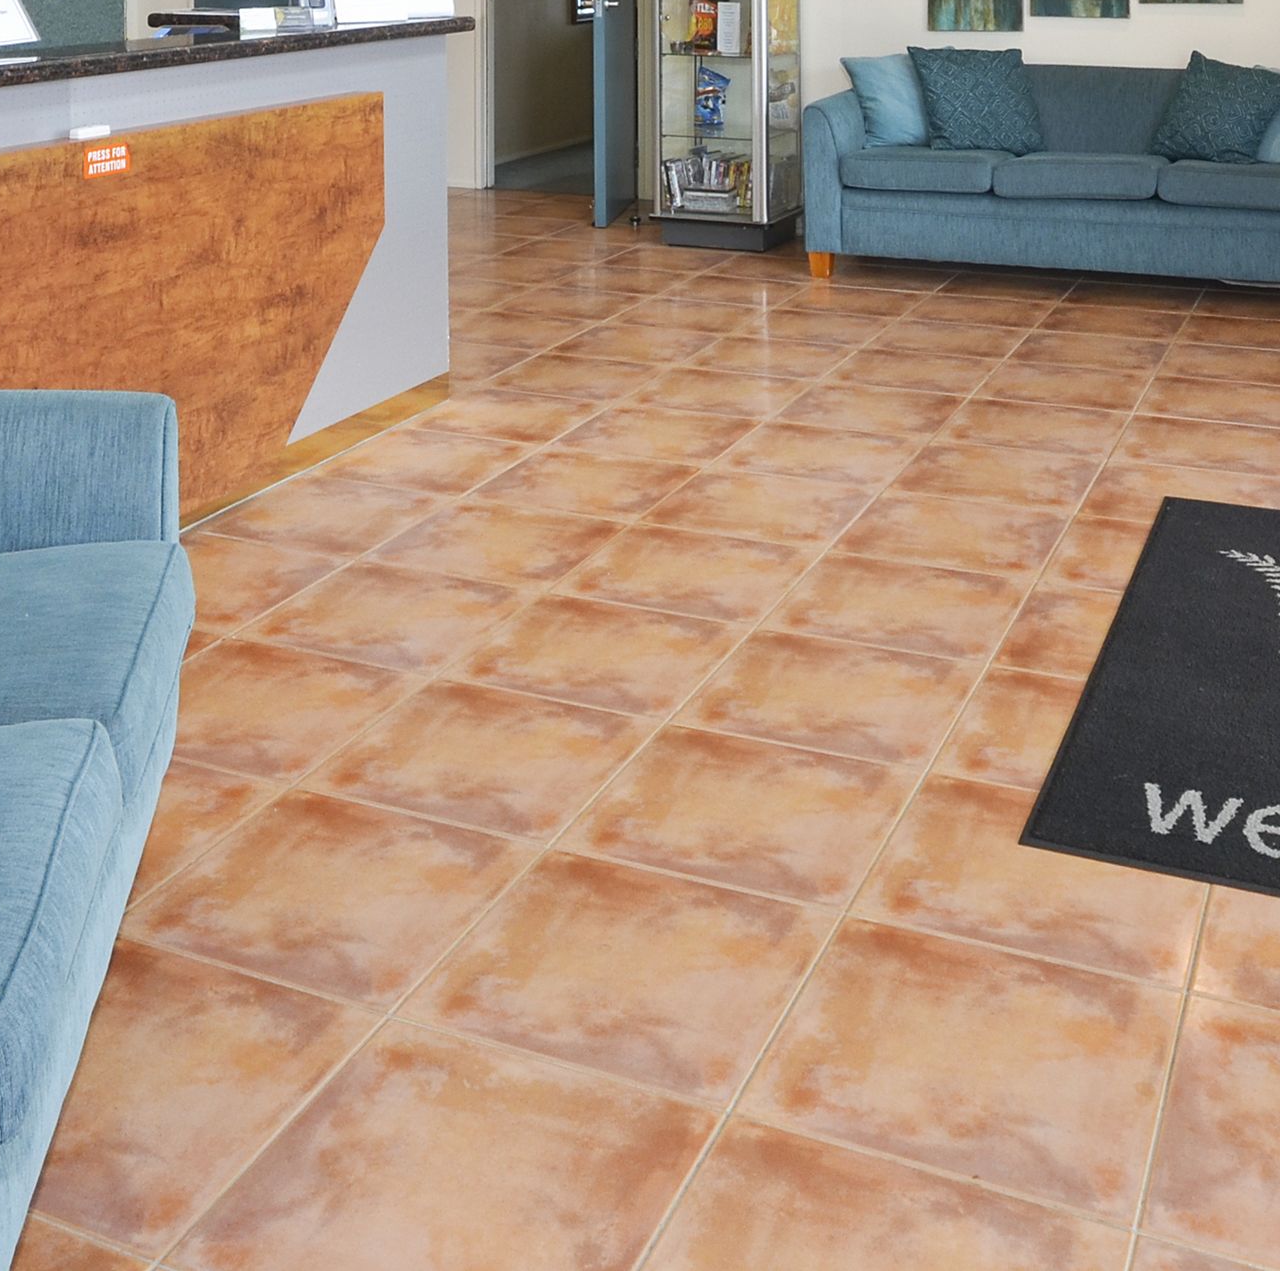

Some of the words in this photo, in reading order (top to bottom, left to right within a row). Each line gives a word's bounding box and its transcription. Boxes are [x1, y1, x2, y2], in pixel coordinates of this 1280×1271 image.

[87, 148, 111, 163] PRESS
[111, 145, 126, 158] FOR
[88, 158, 127, 175] ATTENTION
